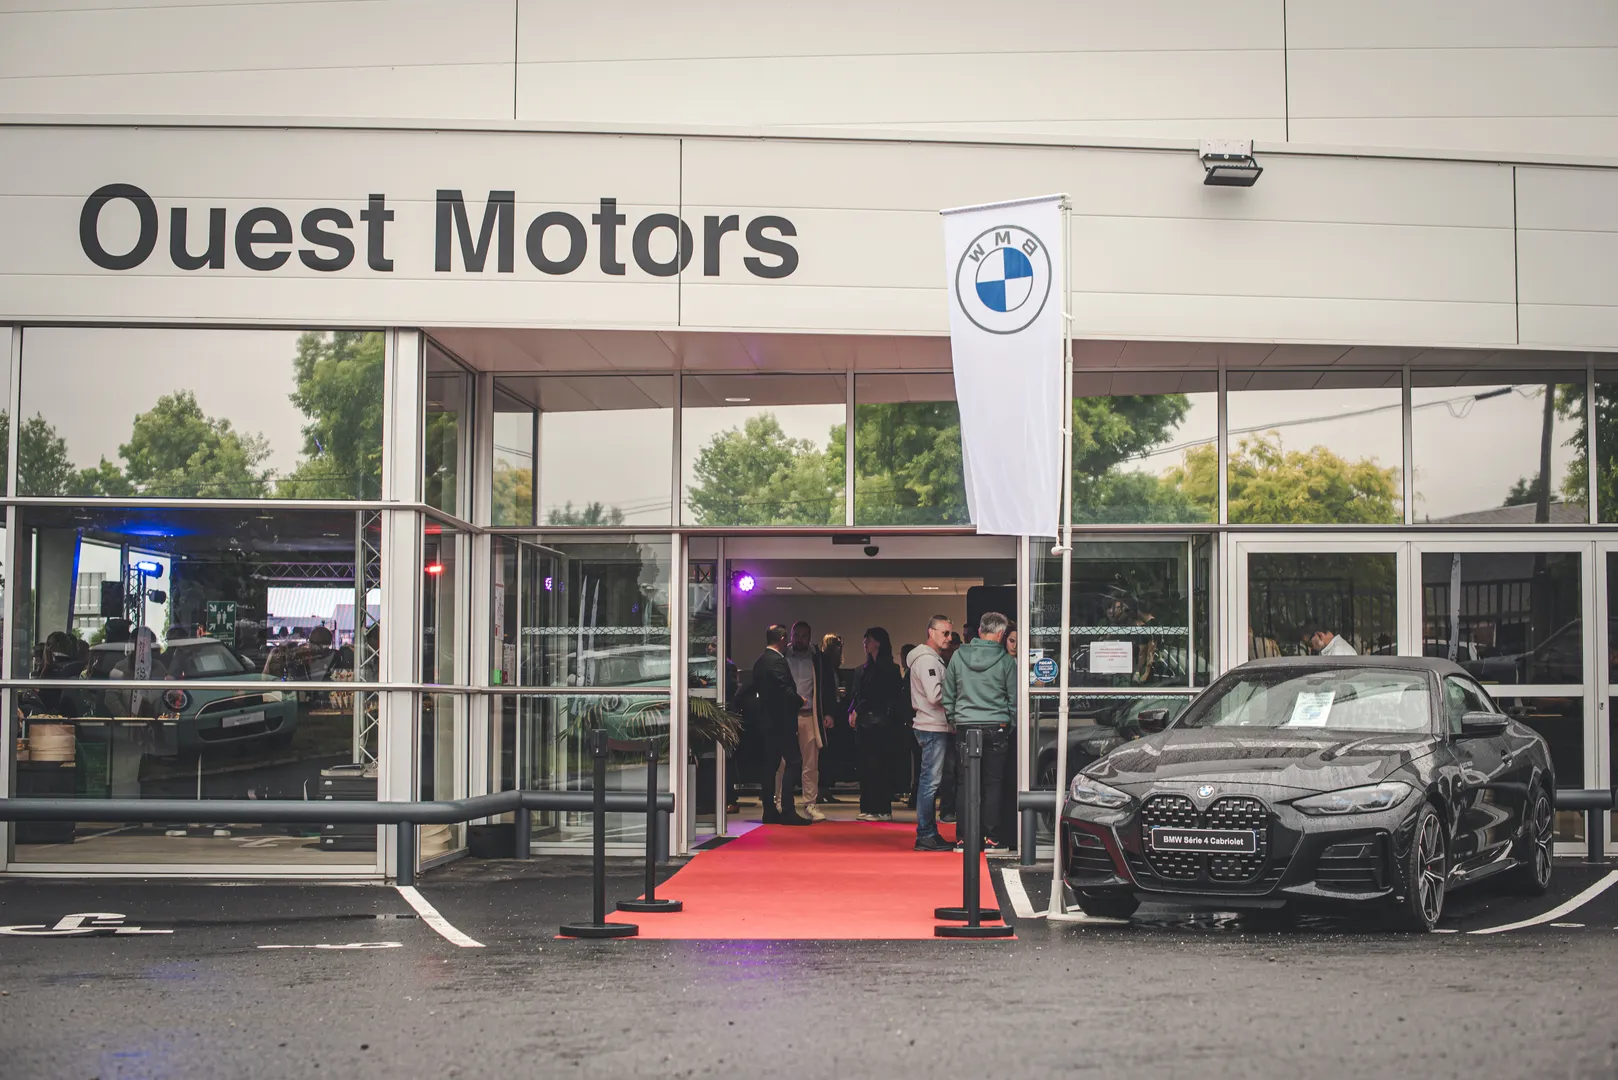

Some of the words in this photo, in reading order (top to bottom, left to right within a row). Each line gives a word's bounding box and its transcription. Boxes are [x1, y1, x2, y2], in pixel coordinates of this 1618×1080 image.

[79, 182, 395, 273] Ouest
[434, 189, 801, 279] Motors
[1163, 835, 1182, 843] BMW
[1183, 836, 1203, 844] Série
[1210, 837, 1244, 845] Cabriolet
